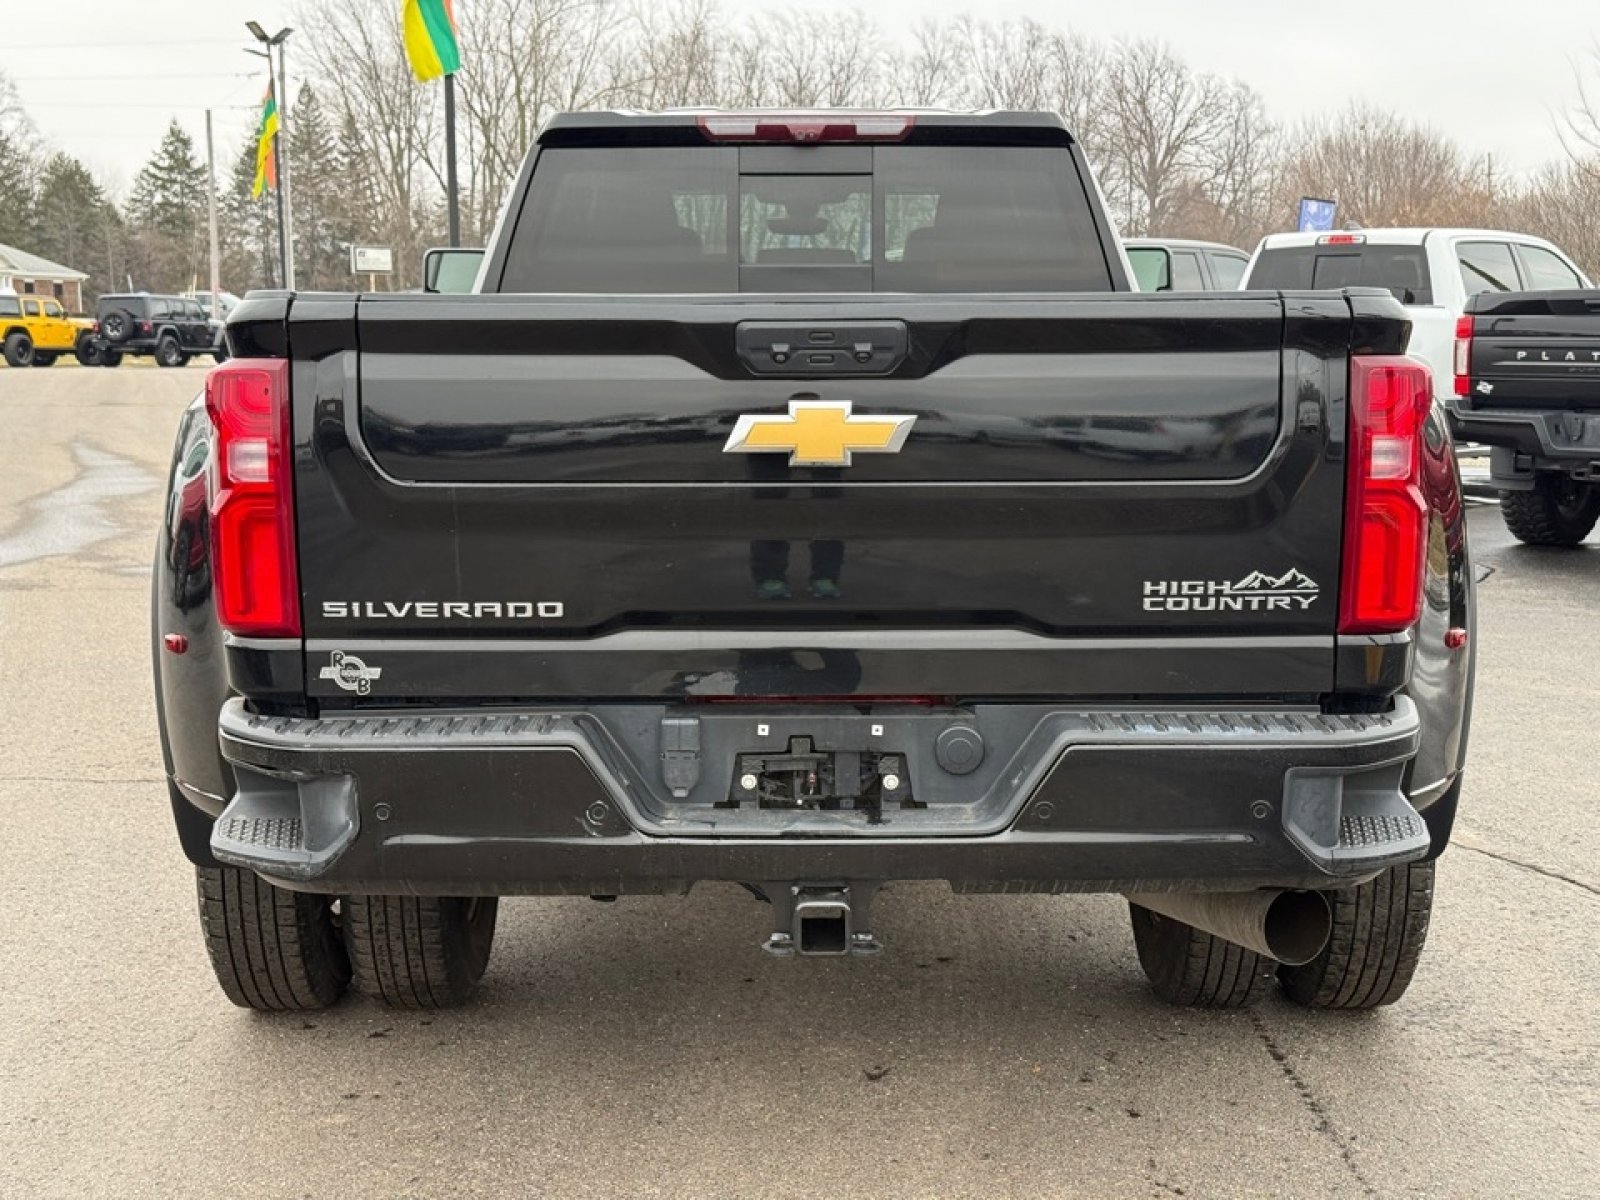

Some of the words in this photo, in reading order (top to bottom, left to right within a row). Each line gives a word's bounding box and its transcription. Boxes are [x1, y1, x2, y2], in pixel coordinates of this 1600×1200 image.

[1143, 580, 1231, 596] HIGH
[322, 601, 564, 618] SILVERADO
[1142, 595, 1319, 611] COUNTRY
